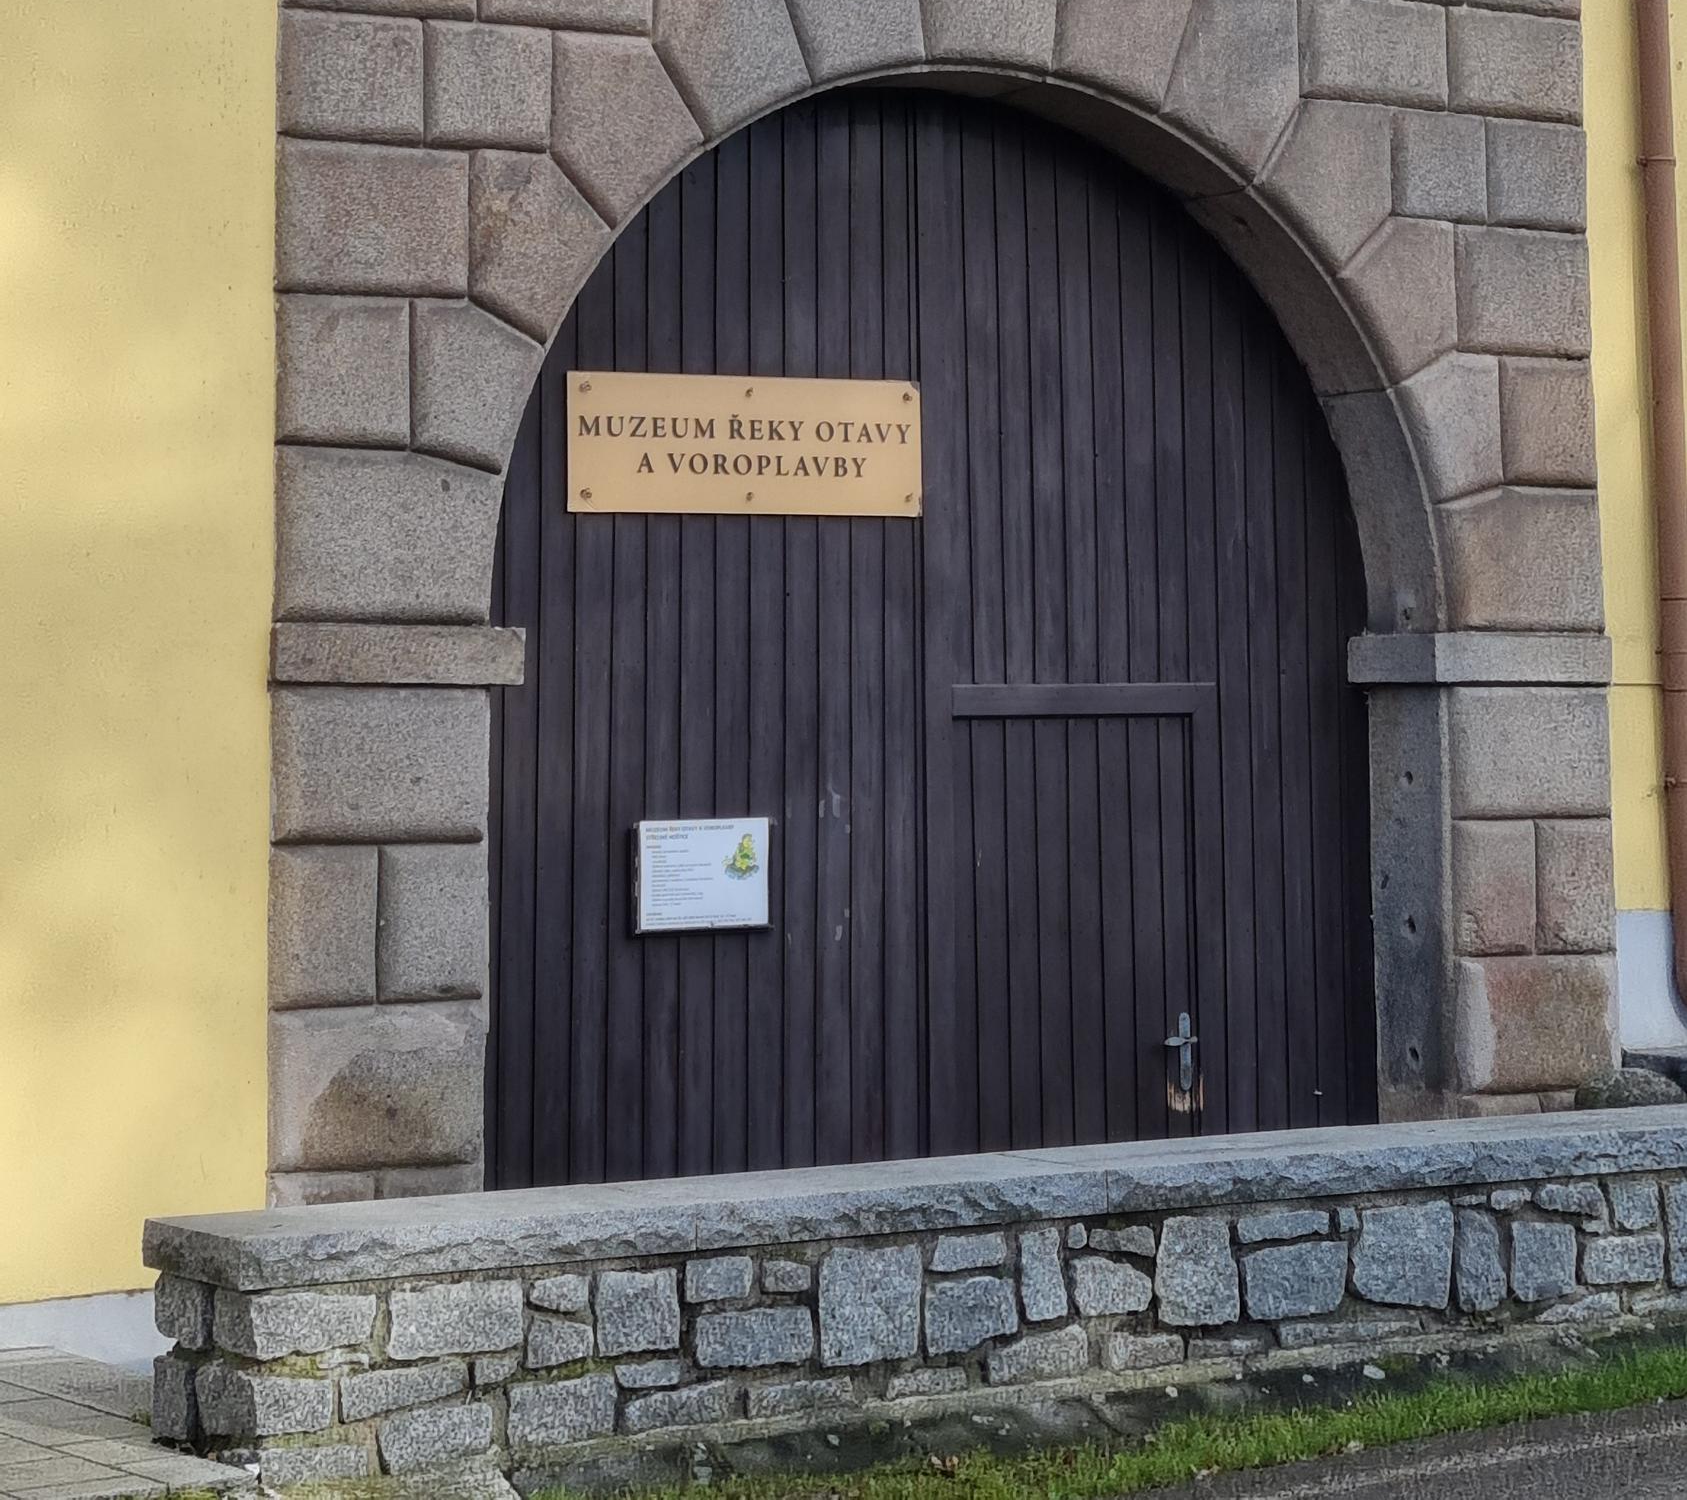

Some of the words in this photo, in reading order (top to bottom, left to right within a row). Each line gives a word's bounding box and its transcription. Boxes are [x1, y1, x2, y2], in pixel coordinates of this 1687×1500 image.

[578, 415, 716, 439] MUZEUM
[728, 414, 804, 442] ŘEKY
[815, 421, 911, 444] OTAVY
[636, 452, 654, 474] A
[667, 453, 867, 478] VOROPLAVBY
